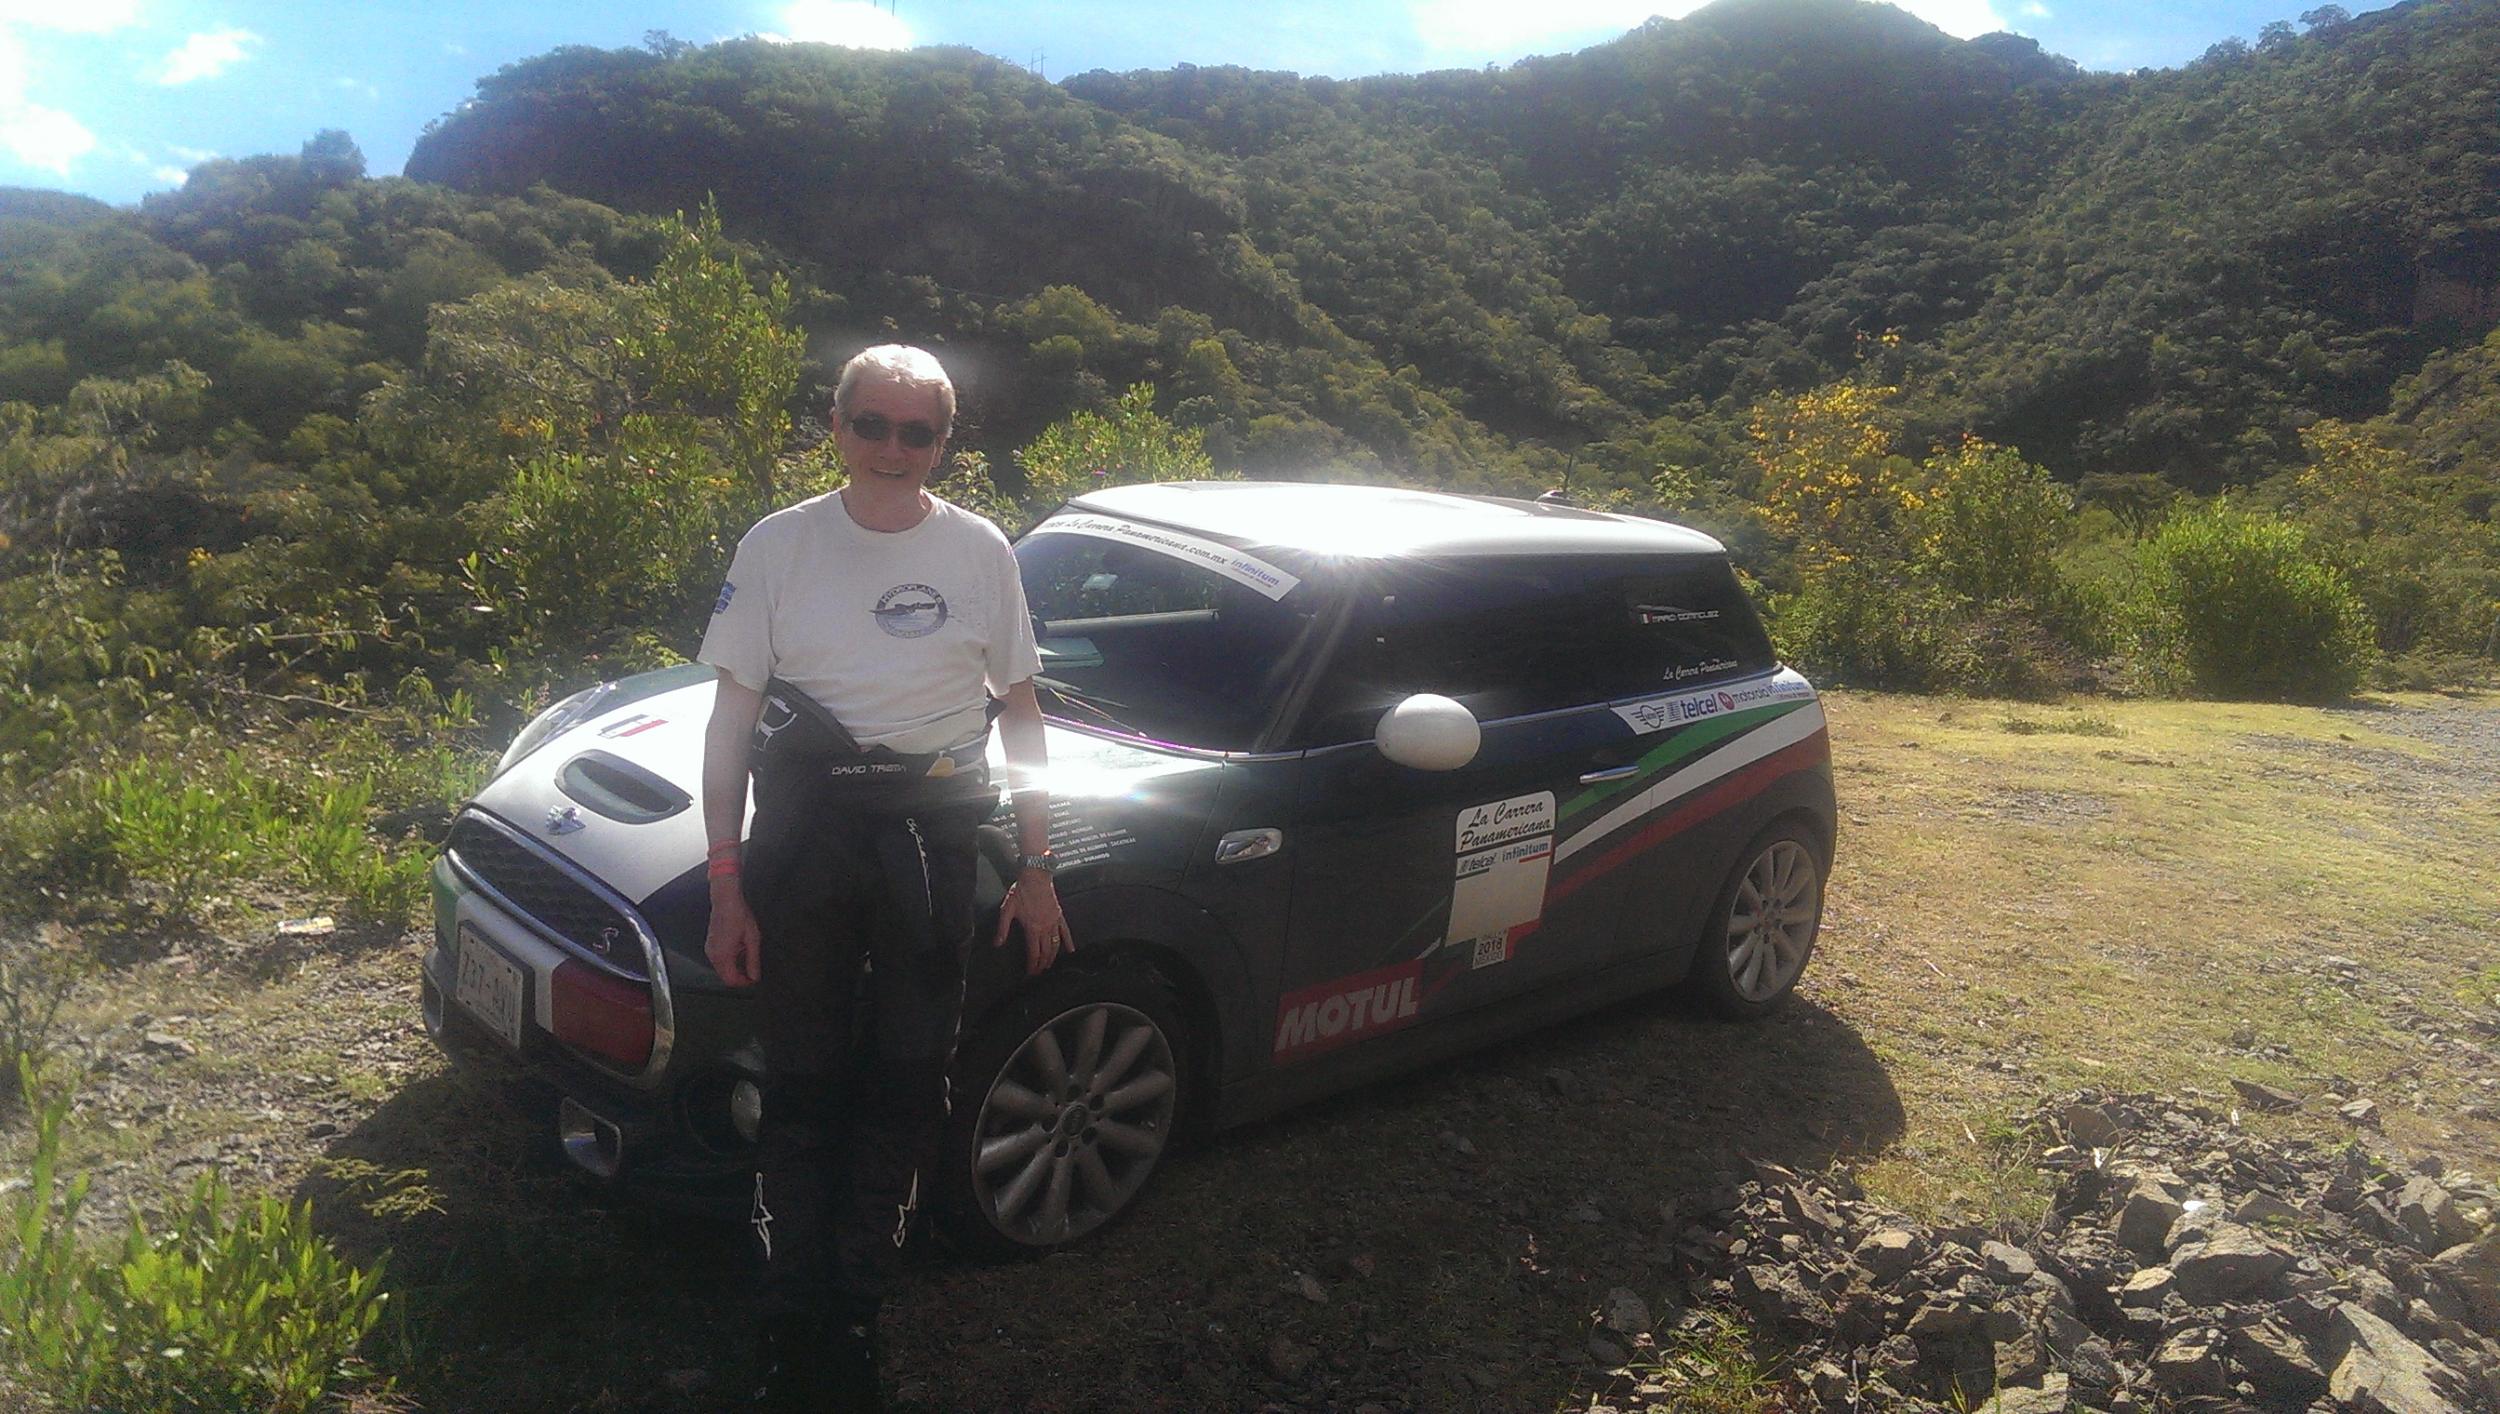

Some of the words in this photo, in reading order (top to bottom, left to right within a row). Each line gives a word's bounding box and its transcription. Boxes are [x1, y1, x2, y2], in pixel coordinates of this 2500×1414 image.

[1231, 558, 1280, 587] infinitum
[1680, 695, 1720, 720] telcel
[831, 764, 867, 776] DAVID
[1468, 807, 1489, 828] La
[1493, 802, 1544, 825] Carrera
[1460, 818, 1551, 850] Panamericana
[1502, 842, 1549, 863] infinitum
[1273, 976, 1419, 1053] MOTUL
